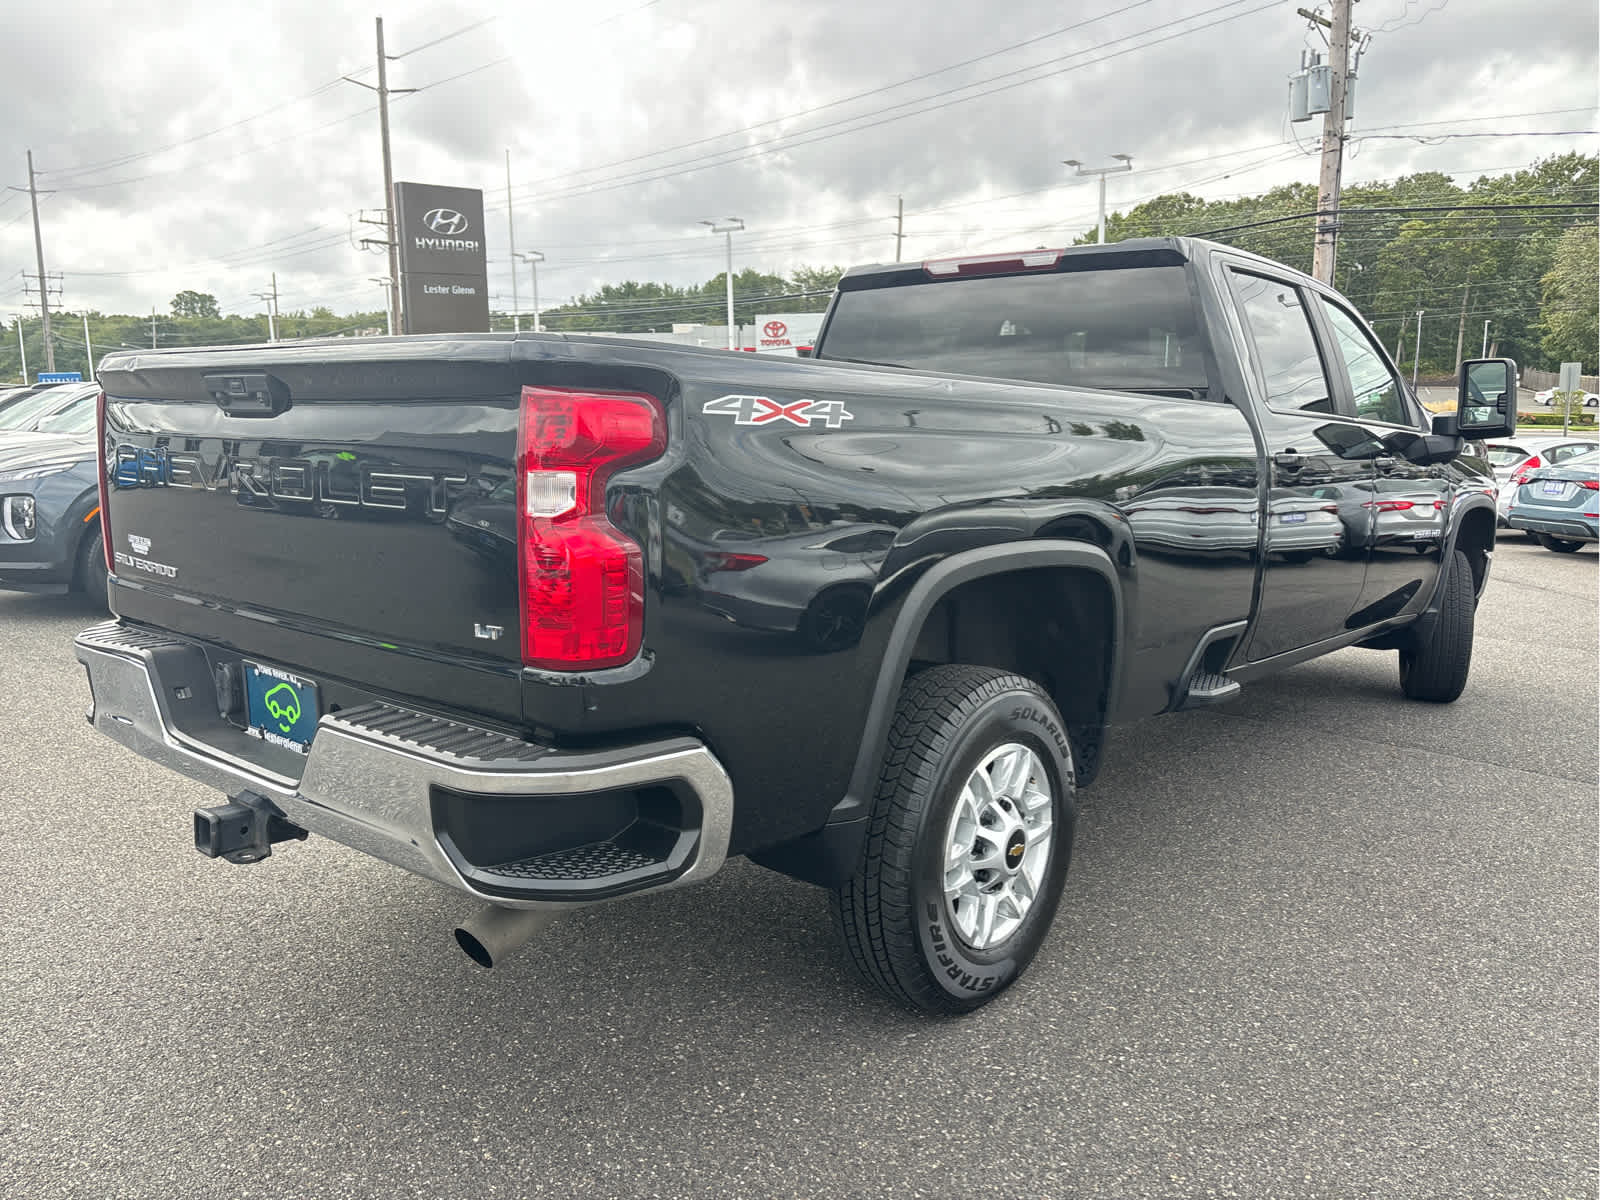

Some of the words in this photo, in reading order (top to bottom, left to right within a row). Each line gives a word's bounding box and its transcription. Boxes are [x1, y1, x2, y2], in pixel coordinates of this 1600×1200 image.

[415, 237, 479, 252] HYUNDAI
[423, 284, 451, 294] Lester
[452, 285, 475, 295] Glenn
[759, 338, 792, 346] TOYOTA
[115, 447, 469, 514] CHEVROLET
[114, 551, 179, 578] SILVERADO
[473, 623, 504, 641] LT
[1009, 706, 1071, 760] SOLARUS
[926, 902, 995, 992] STARFIRE
